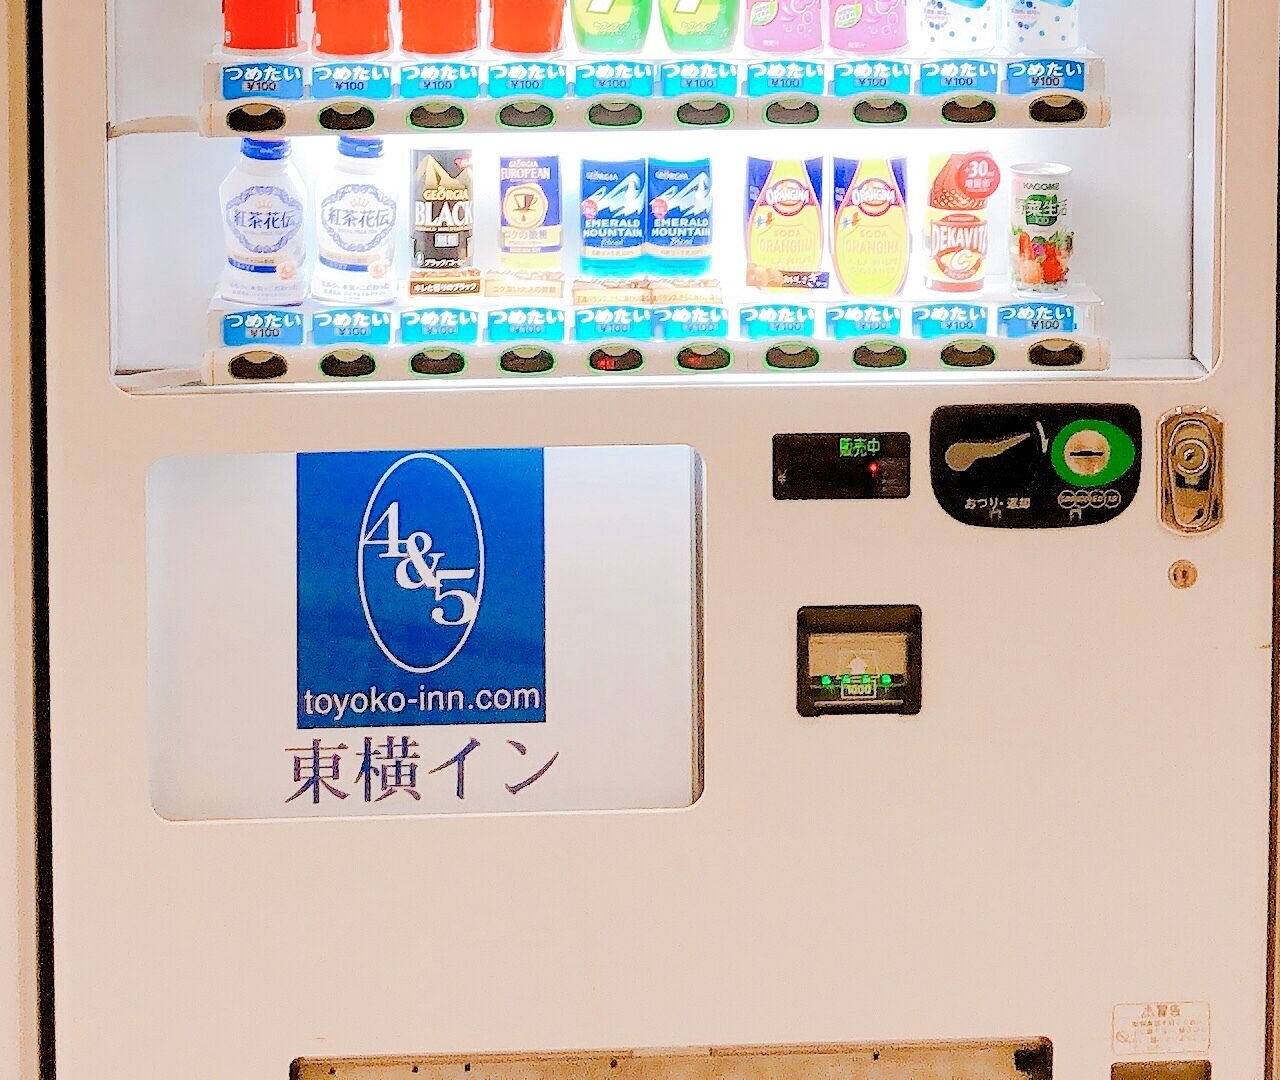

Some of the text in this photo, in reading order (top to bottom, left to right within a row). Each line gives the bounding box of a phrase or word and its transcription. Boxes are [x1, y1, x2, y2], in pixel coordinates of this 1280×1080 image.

[224, 67, 302, 80] つめたい
[314, 67, 390, 80] つめたい
[923, 63, 996, 78] つめたい
[1008, 63, 1082, 78] つめたい
[246, 81, 276, 91] ¥100
[335, 81, 364, 91] ¥100
[423, 81, 452, 91] ¥100
[511, 81, 539, 91] ¥100
[685, 78, 713, 87] ¥100
[945, 78, 973, 87] ¥100
[1031, 76, 1060, 87] ¥100
[501, 168, 551, 180] EUROPEAN
[1024, 182, 1059, 191] KAGOME
[766, 189, 809, 203] ORANGINA
[852, 189, 895, 203] ORANGINA
[233, 209, 294, 230] 紅茶花伝
[327, 209, 389, 228] 紅茶花伝
[415, 201, 473, 227] BLACK
[585, 219, 641, 228] EMERALD
[654, 218, 709, 228] EMERALD
[583, 228, 643, 237] MOUNTAIN
[651, 227, 711, 237] MOUNTAIN
[229, 313, 303, 328] つめたい
[315, 313, 390, 328] つめたい
[913, 307, 986, 322] つめたい
[999, 307, 1072, 322] つめたい
[1031, 320, 1059, 331] ¥100
[839, 437, 881, 457] 販売中
[362, 501, 480, 626] 4&5
[304, 685, 540, 722] toyoko-inn.com
[284, 736, 561, 805] 東横イン
